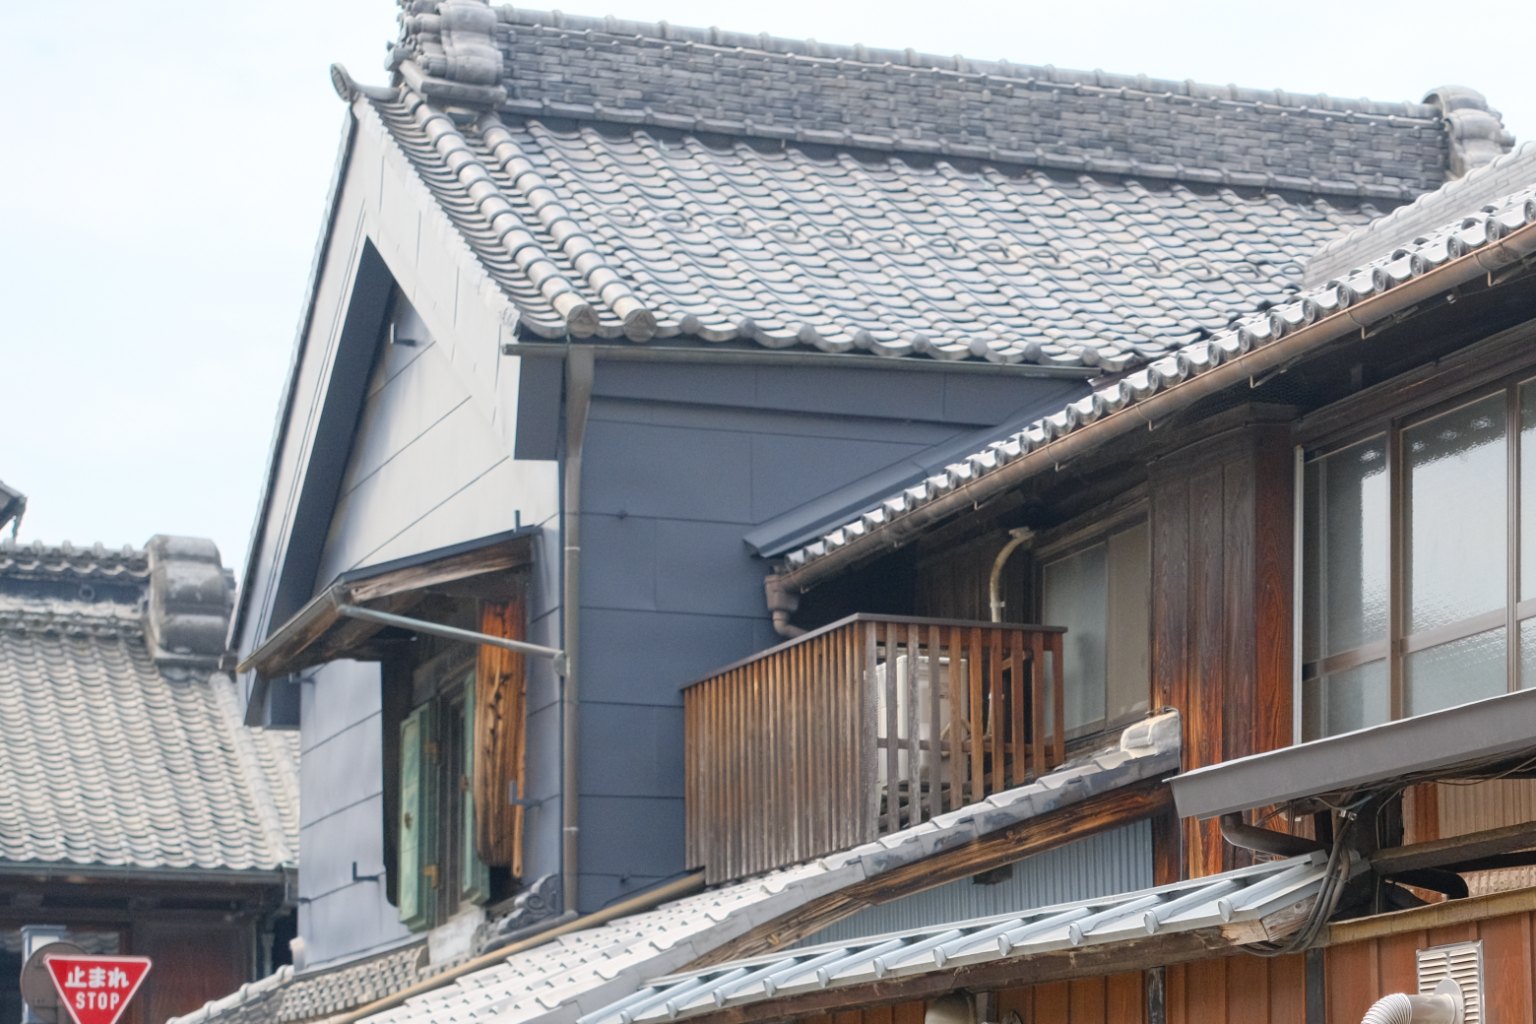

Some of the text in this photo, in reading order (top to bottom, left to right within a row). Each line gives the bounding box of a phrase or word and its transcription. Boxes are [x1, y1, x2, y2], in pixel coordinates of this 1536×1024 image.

[65, 965, 129, 988] 止まれ
[75, 991, 120, 1010] STOP
